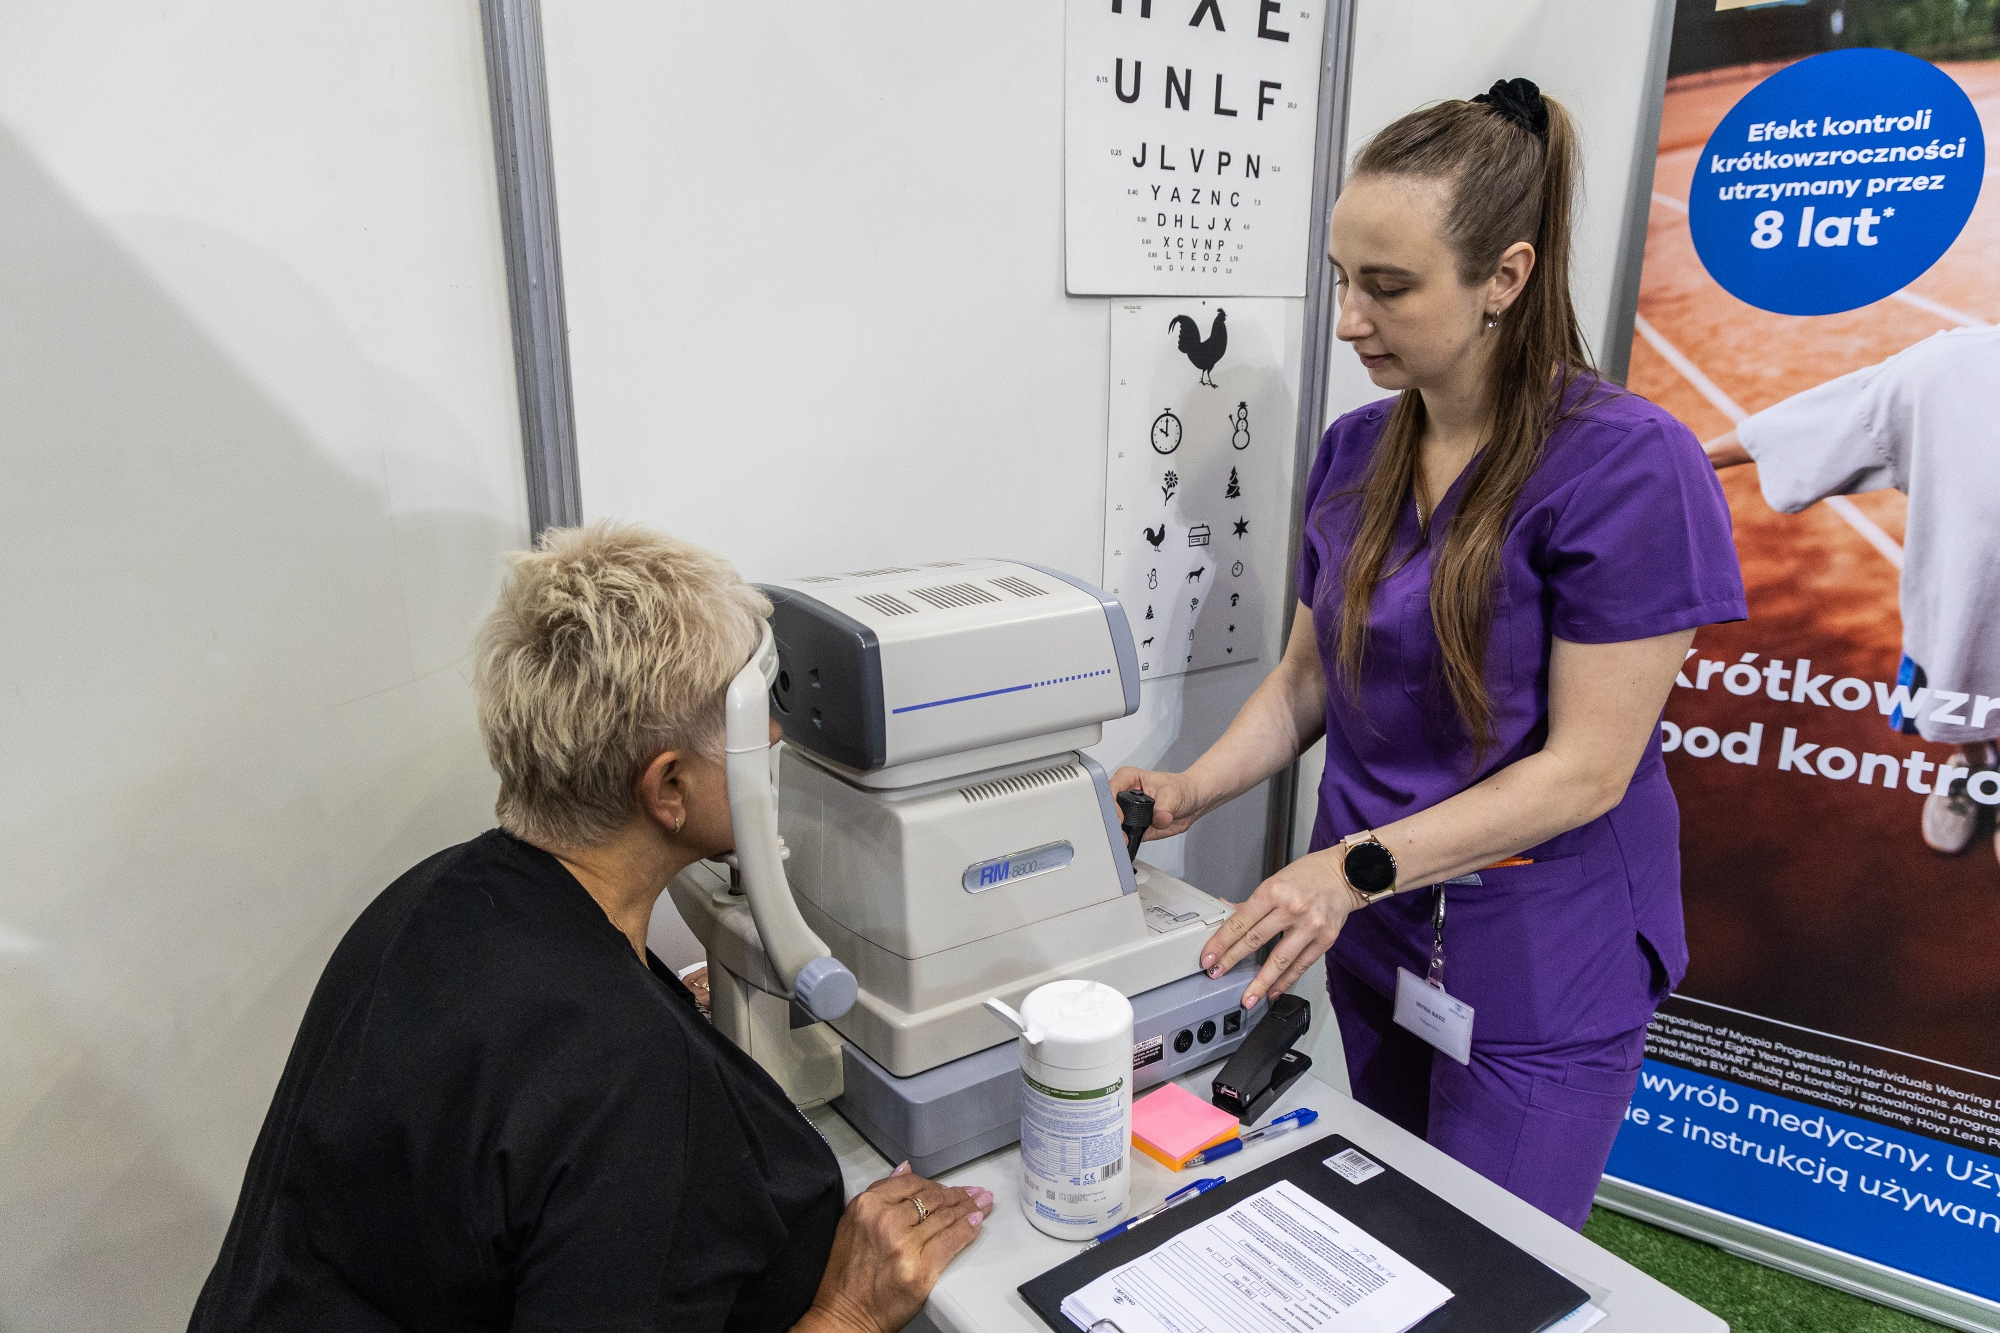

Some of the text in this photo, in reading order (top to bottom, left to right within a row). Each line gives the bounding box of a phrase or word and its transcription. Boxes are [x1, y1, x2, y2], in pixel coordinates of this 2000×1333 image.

[1711, 137, 1967, 174] krótkowzroczności
[1747, 108, 1934, 143] Efekt kontroli
[1719, 173, 1946, 202] utrzymany przez
[1750, 209, 1785, 249] 8
[1777, 727, 2000, 805] kontro
[1652, 1011, 1713, 1033] omparison
[1714, 1027, 1728, 1036] of
[1729, 1030, 1772, 1049] Myopia
[1774, 1042, 1846, 1068] Progression
[1848, 1061, 1860, 1072] in
[1862, 1065, 1933, 1091] Individuals
[1935, 1084, 1992, 1108] Wearing
[1659, 1047, 1708, 1068] Holdings
[1730, 1066, 1780, 1088] Podmiot
[1781, 1082, 1857, 1109] prowadzący
[1915, 1117, 1951, 1134] Hoya
[1953, 1128, 1985, 1145] Lens
[1665, 1025, 1705, 1043] Lenses
[1706, 1035, 1723, 1046] for
[1724, 1040, 1756, 1058] Eight
[1758, 1049, 1791, 1066] Years
[1792, 1060, 1832, 1077] versus
[1834, 1070, 1882, 1090] Shorter
[1883, 1083, 1950, 1109] Durations.
[1953, 1103, 2000, 1122] Abstra
[1785, 1070, 1802, 1081] do
[1803, 1074, 1853, 1096] korekcji
[1860, 1090, 1947, 1121] spowalniania
[1642, 1071, 1740, 1114] wyrób
[1747, 1102, 1933, 1172] medyczny.
[1656, 1114, 1675, 1134] z
[1682, 1116, 1849, 1193] instrukcją
[1859, 1174, 2000, 1234] używan
